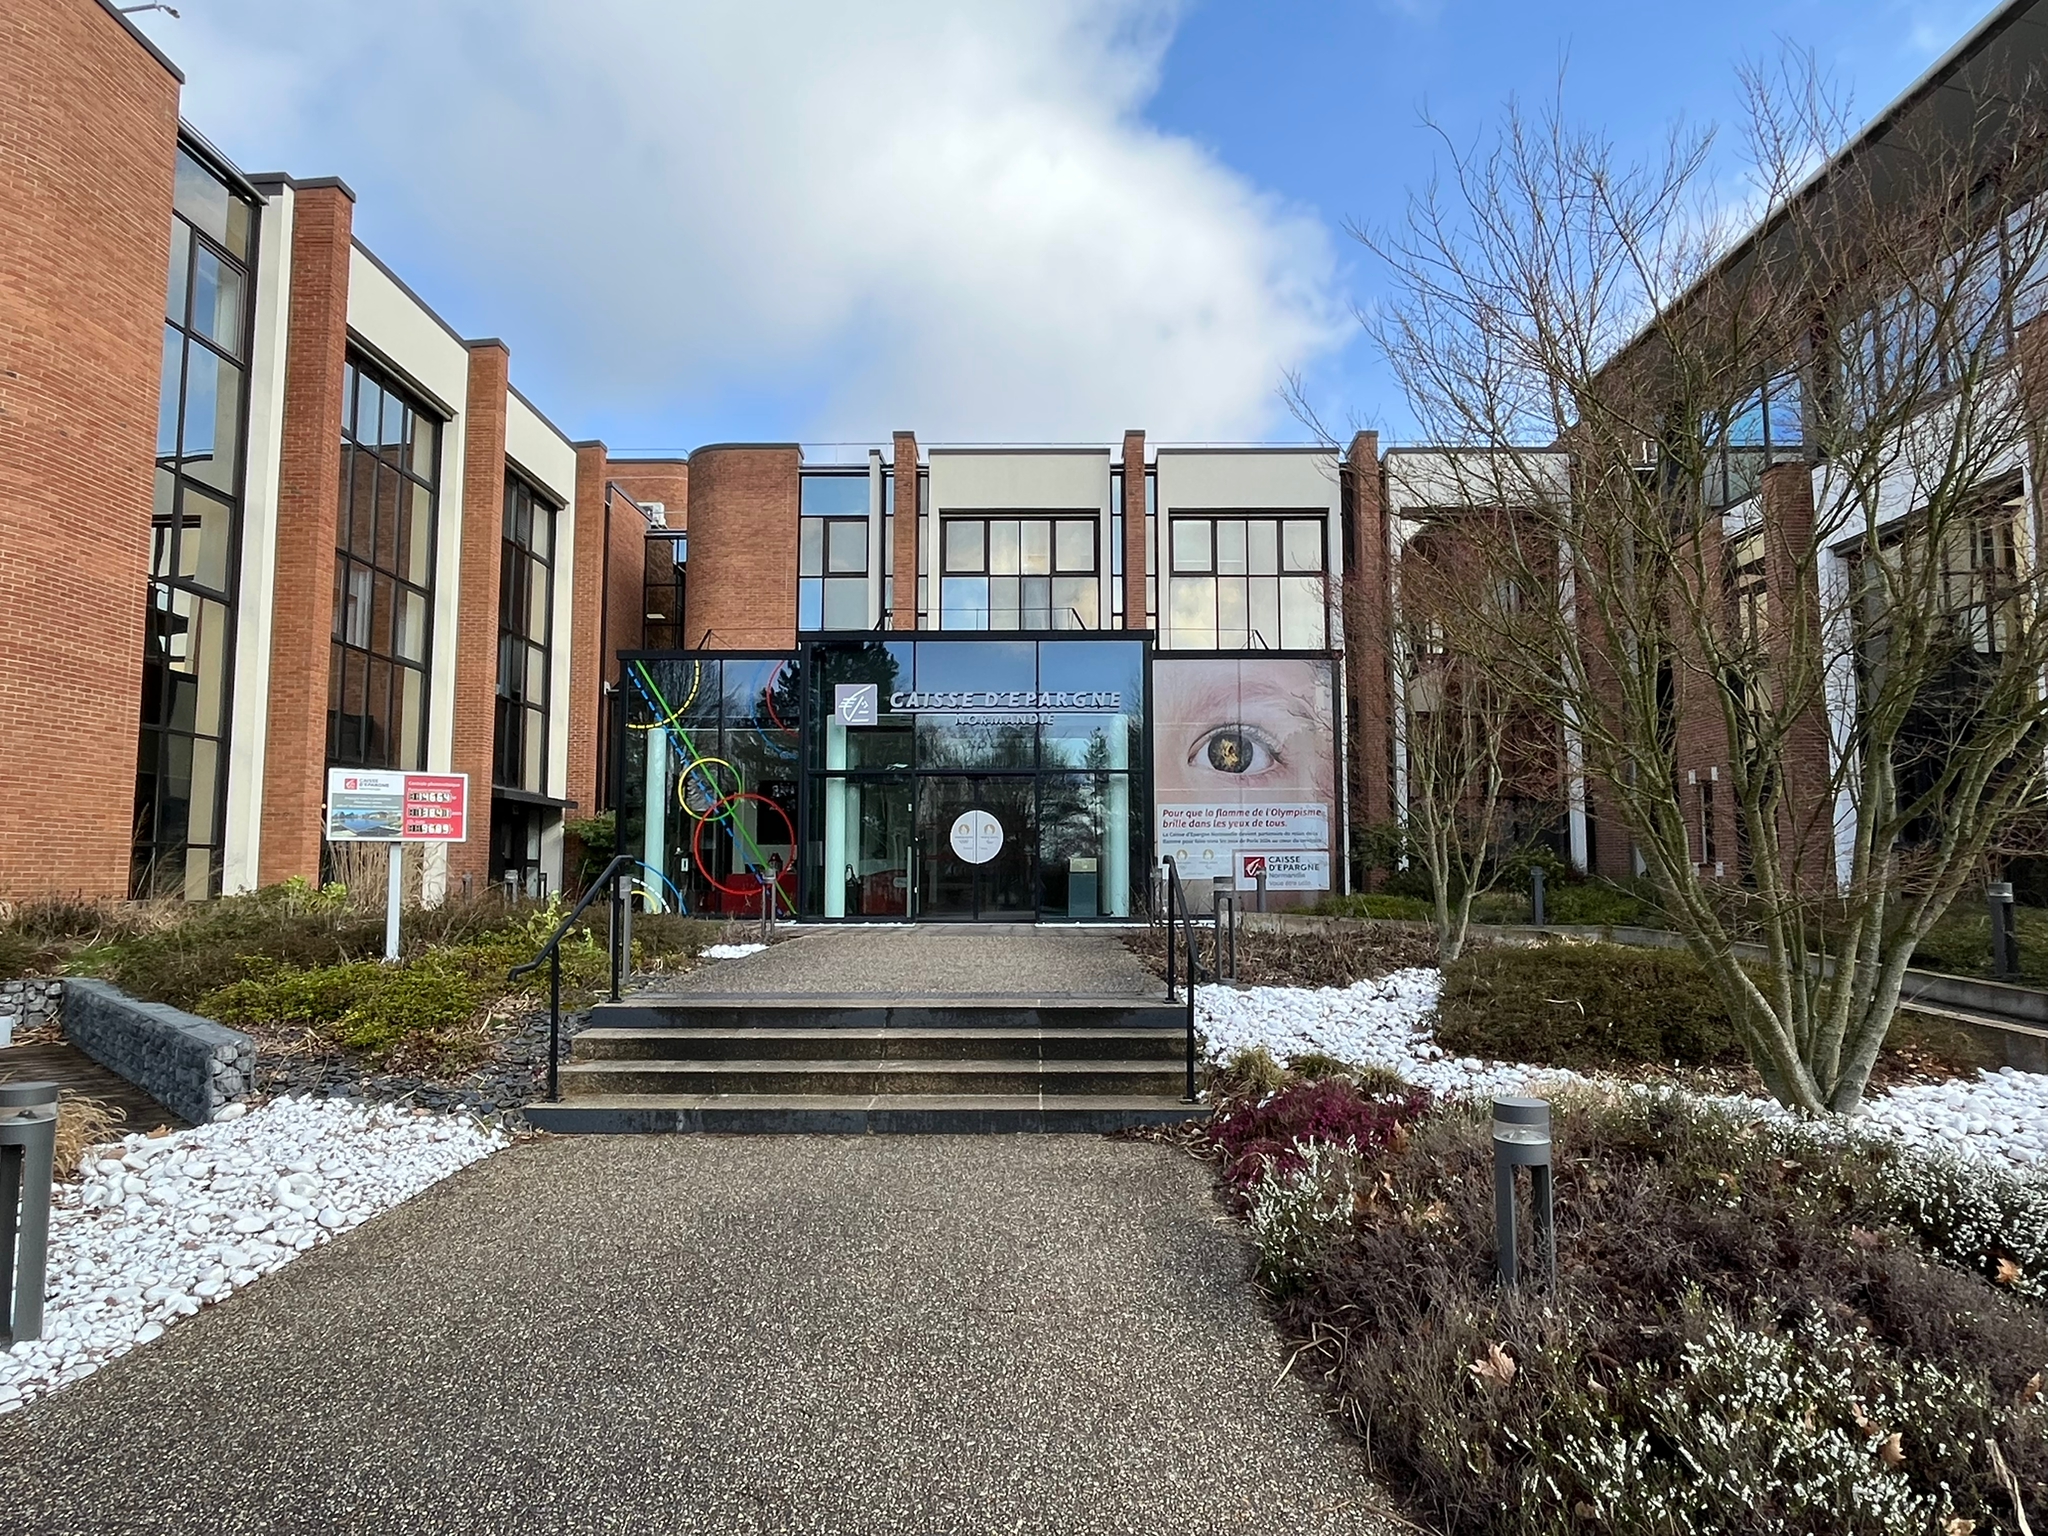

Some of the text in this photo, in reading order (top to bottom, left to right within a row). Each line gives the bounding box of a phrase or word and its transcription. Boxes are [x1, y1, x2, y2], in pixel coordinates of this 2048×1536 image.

[889, 691, 1121, 708] CAISSE D'EPARGNE
[954, 713, 1055, 726] NORMANDIE
[1162, 807, 1322, 819] Pour que la flamme de l'Olympisme
[1162, 819, 1288, 830] brille dans les yeux de tous.
[1268, 855, 1301, 864] CAISSE
[1268, 863, 1320, 872] D'EPARGNE
